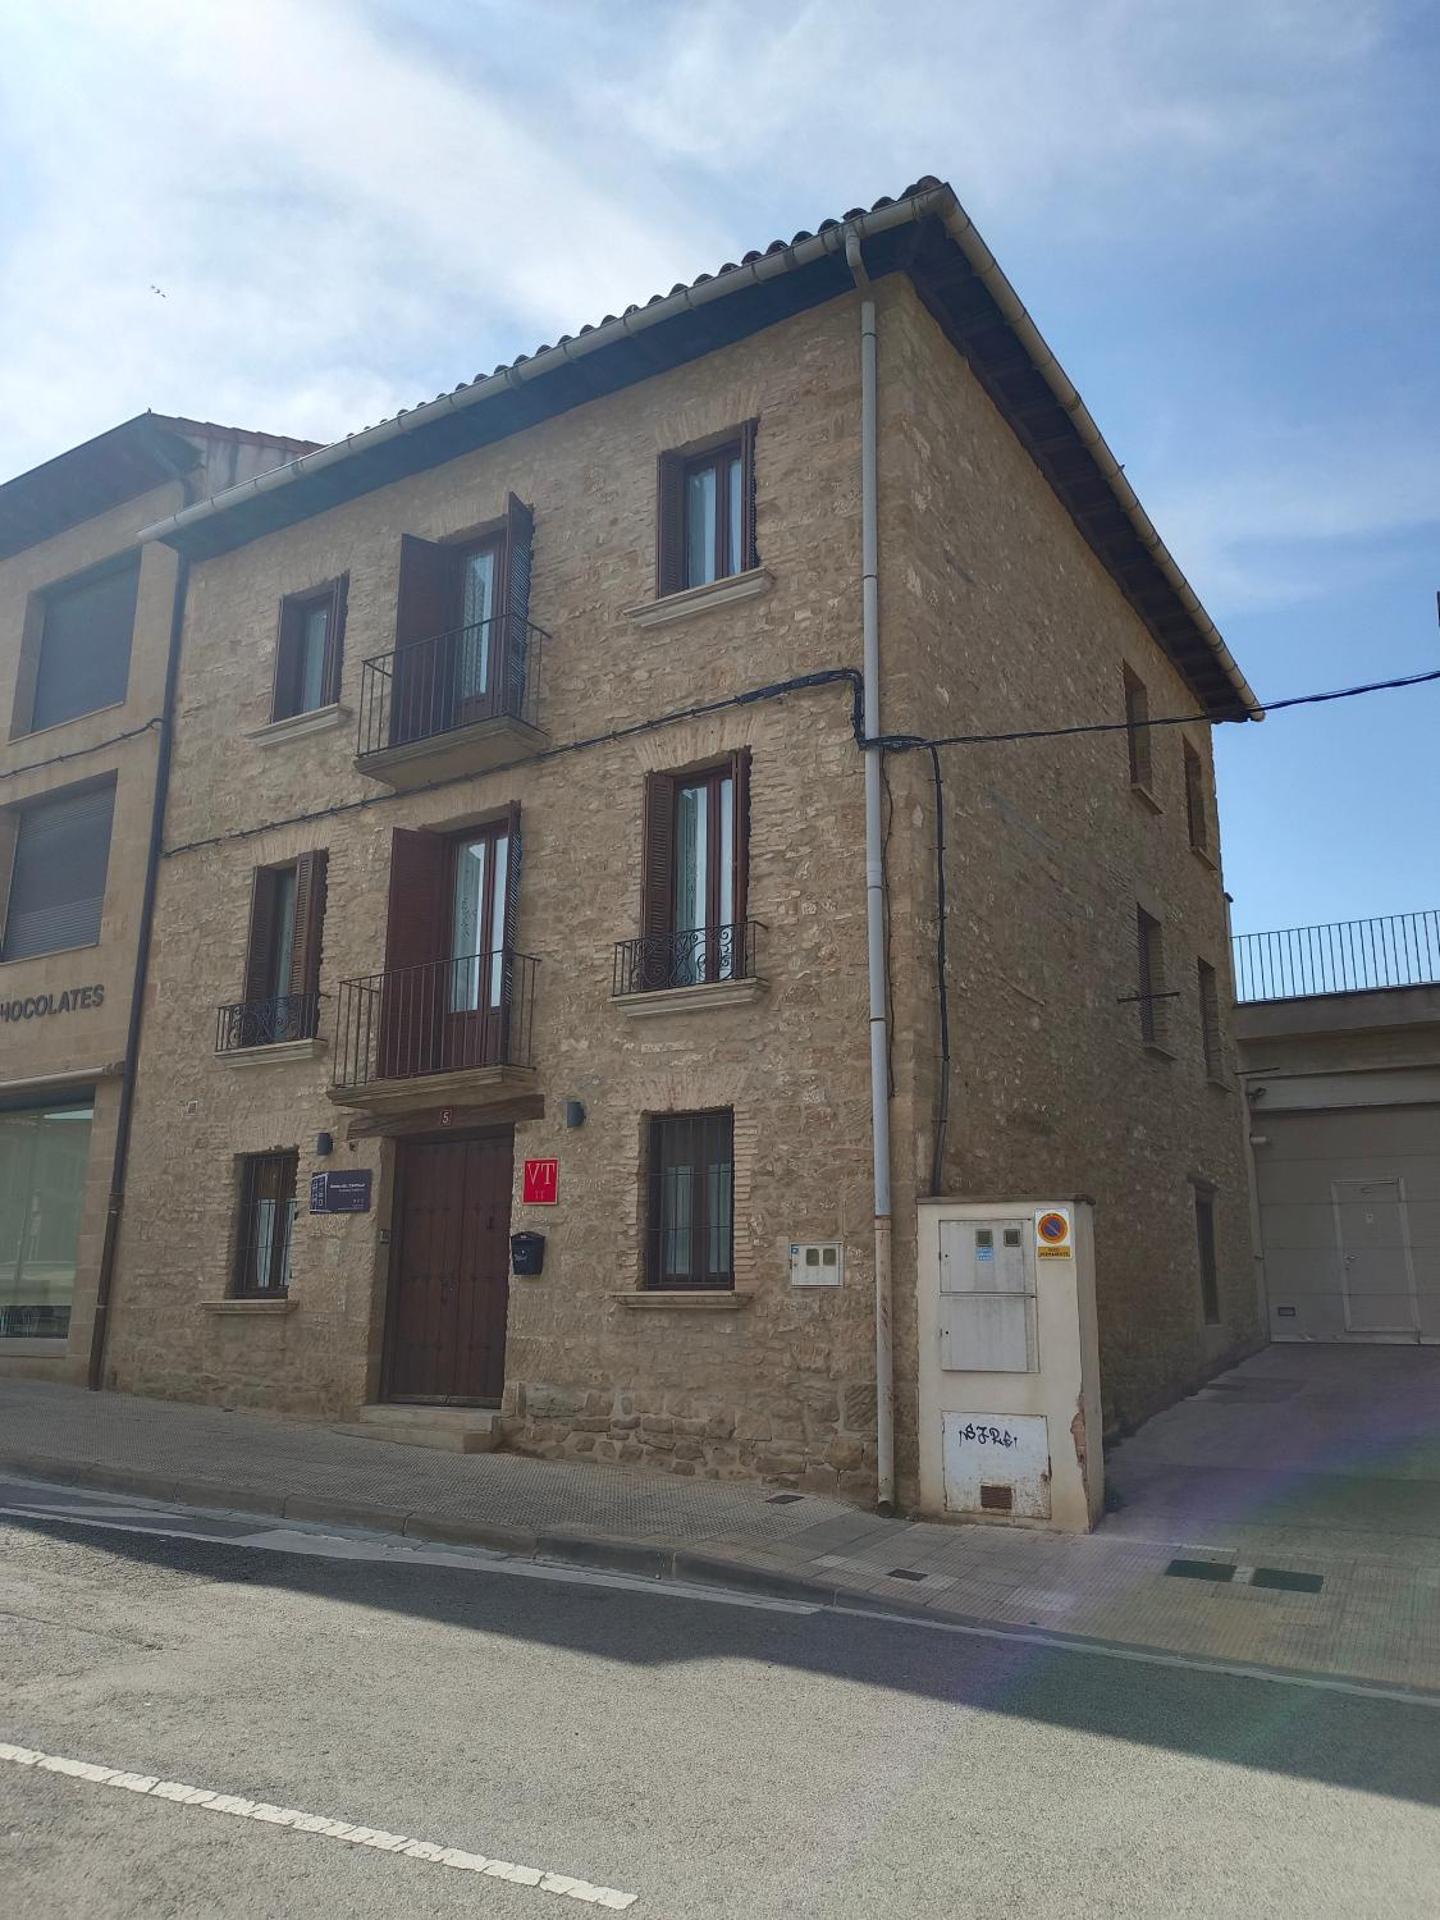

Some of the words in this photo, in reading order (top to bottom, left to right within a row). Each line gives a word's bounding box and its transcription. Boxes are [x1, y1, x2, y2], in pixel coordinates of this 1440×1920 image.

[0, 984, 105, 1022] HOCOLATES
[442, 1111, 450, 1124] 5
[527, 1162, 555, 1185] VT
